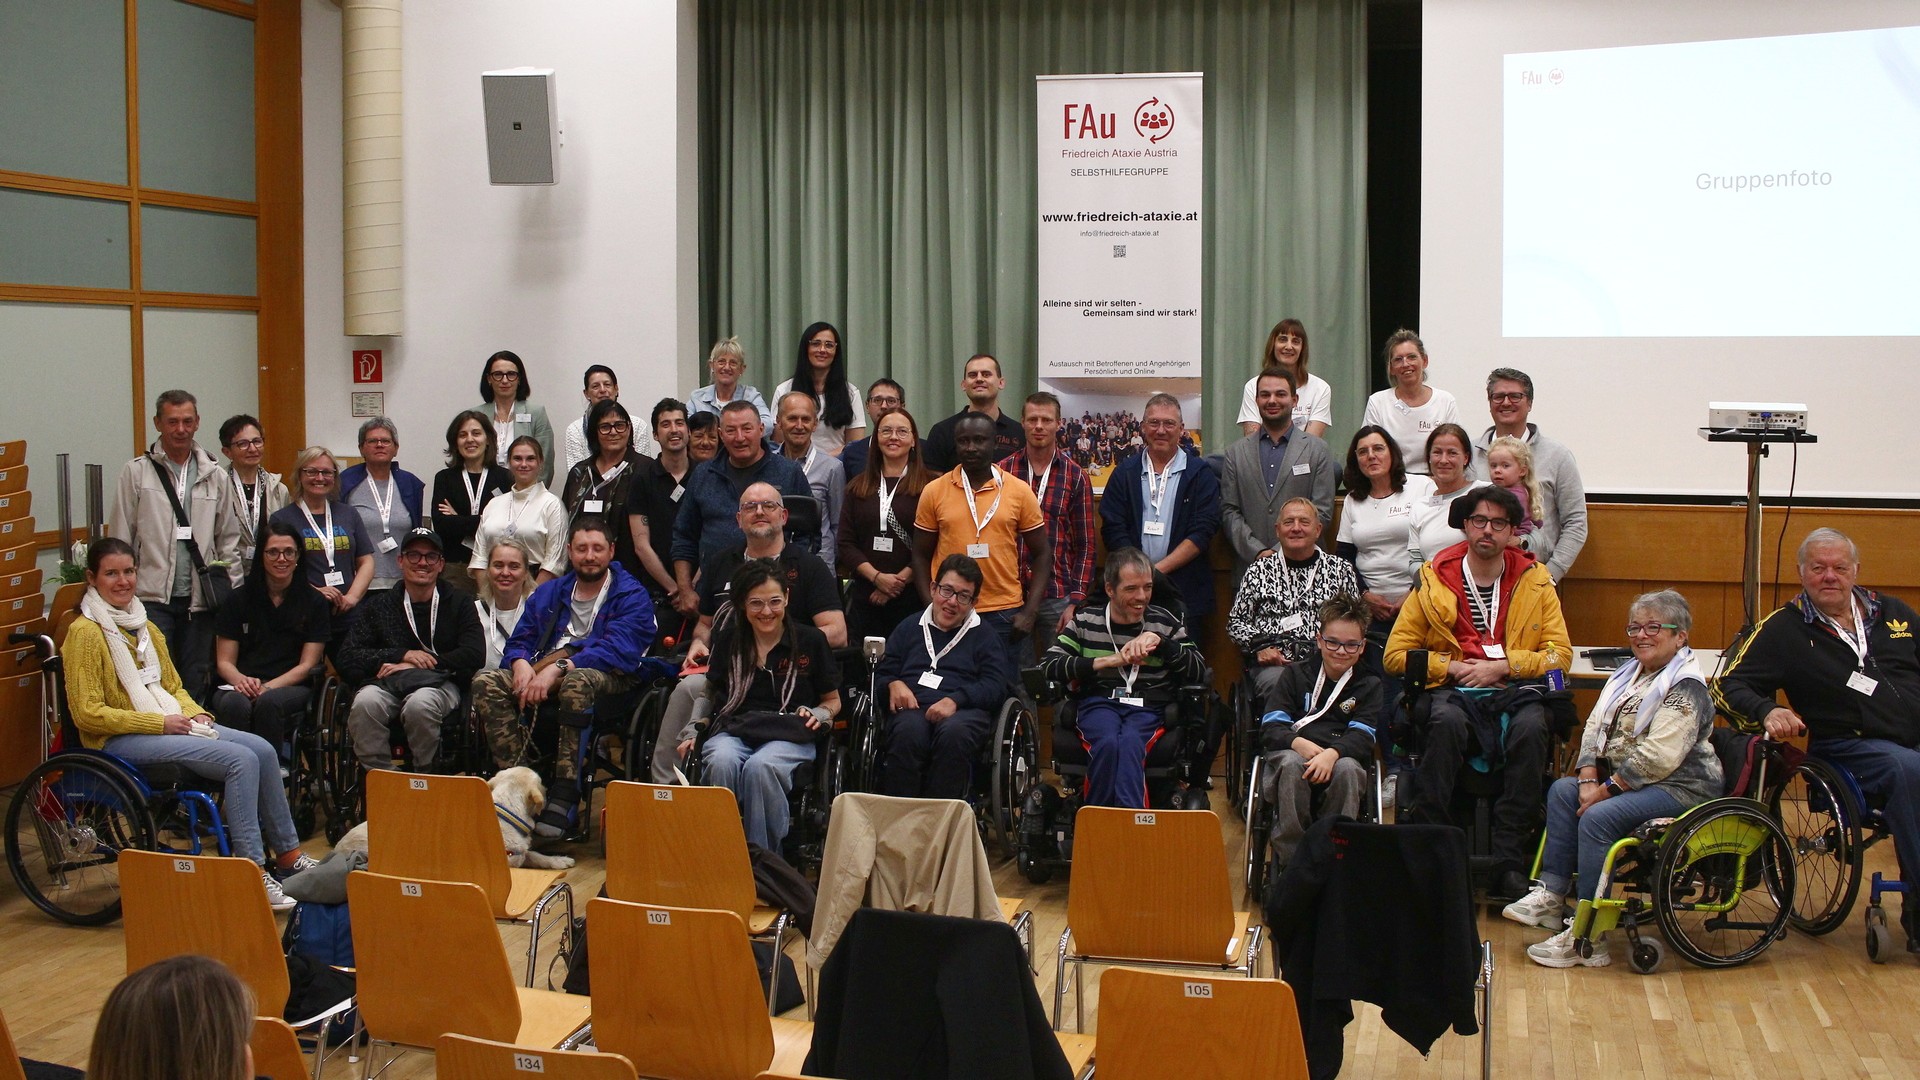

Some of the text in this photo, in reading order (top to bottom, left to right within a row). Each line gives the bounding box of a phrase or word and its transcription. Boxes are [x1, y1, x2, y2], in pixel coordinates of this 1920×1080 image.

[1522, 71, 1542, 85] FAu
[1064, 104, 1116, 139] FAu
[1061, 148, 1178, 158] Friedreich Ataxie Austria
[1070, 168, 1169, 177] SELBSTHILFEGRUPPE
[1696, 170, 1832, 192] Gruppenfoto
[1042, 211, 1198, 222] www.friedreich-ataxie.at
[1042, 300, 1072, 308] Alleine
[1073, 299, 1093, 307] sind
[1094, 299, 1108, 307] wir
[1110, 299, 1137, 307] selten
[1082, 308, 1197, 317] Gemeinsam sind wir stark!
[1149, 360, 1191, 368] Angehörigen
[1419, 420, 1431, 429] FAu
[1389, 506, 1402, 514] FAu
[413, 780, 425, 789] 30
[657, 790, 668, 799] 32
[1137, 815, 1154, 824] 142
[178, 861, 191, 871] 35
[406, 885, 418, 895] 13
[649, 913, 668, 923] 107
[1187, 985, 1210, 996] 105
[517, 1057, 541, 1071] 134
